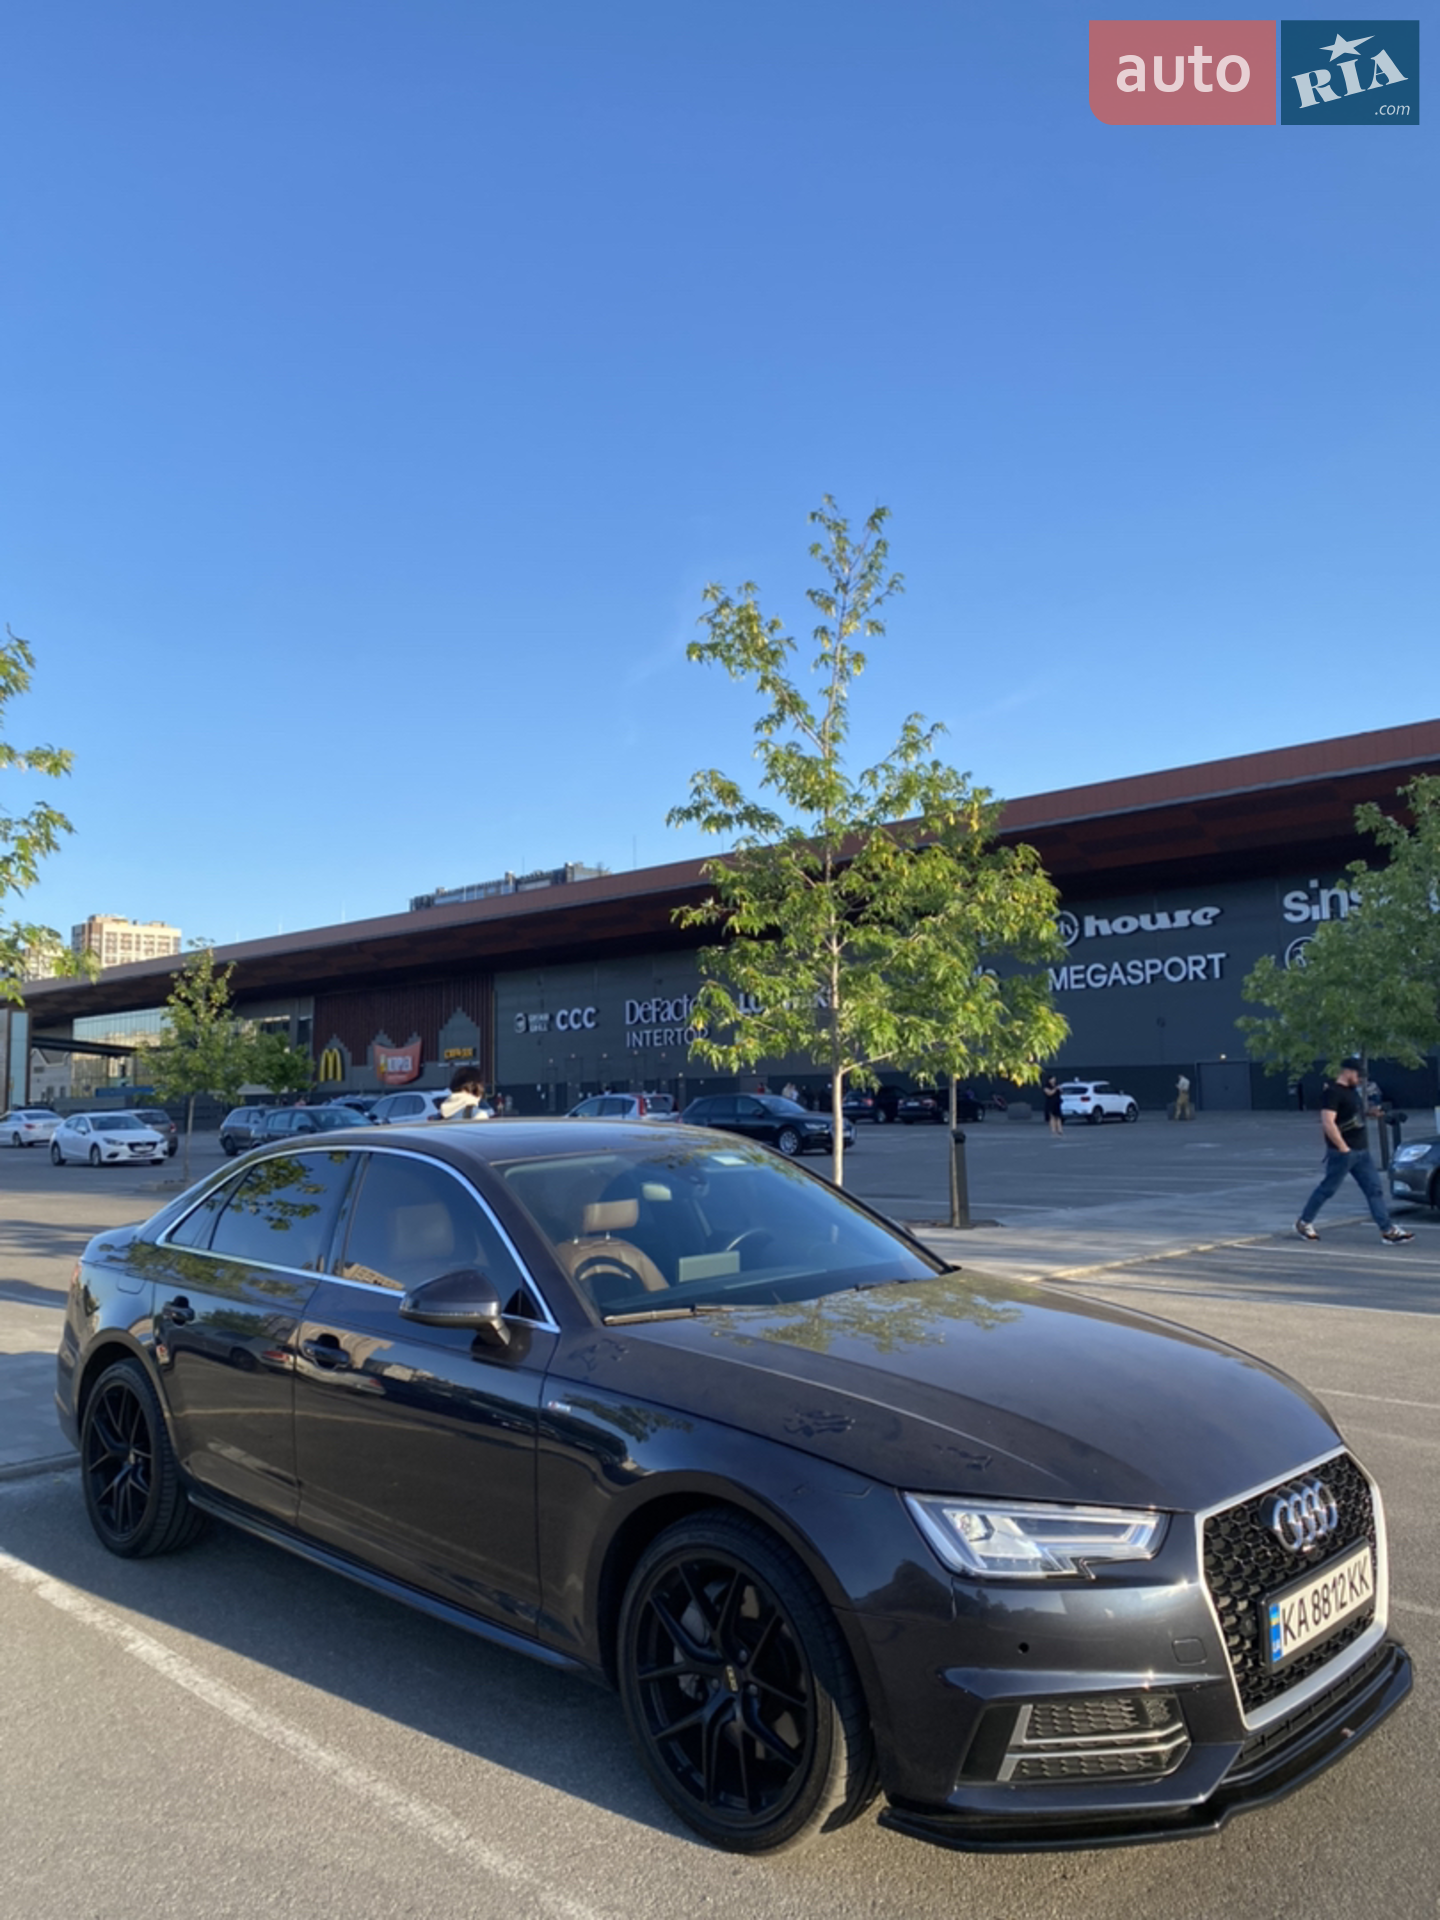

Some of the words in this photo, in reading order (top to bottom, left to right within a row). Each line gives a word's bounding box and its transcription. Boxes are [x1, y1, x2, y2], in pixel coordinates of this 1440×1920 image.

[1084, 907, 1221, 938] house
[1049, 953, 1226, 991] MEGASPORT
[556, 1006, 597, 1032] CCC
